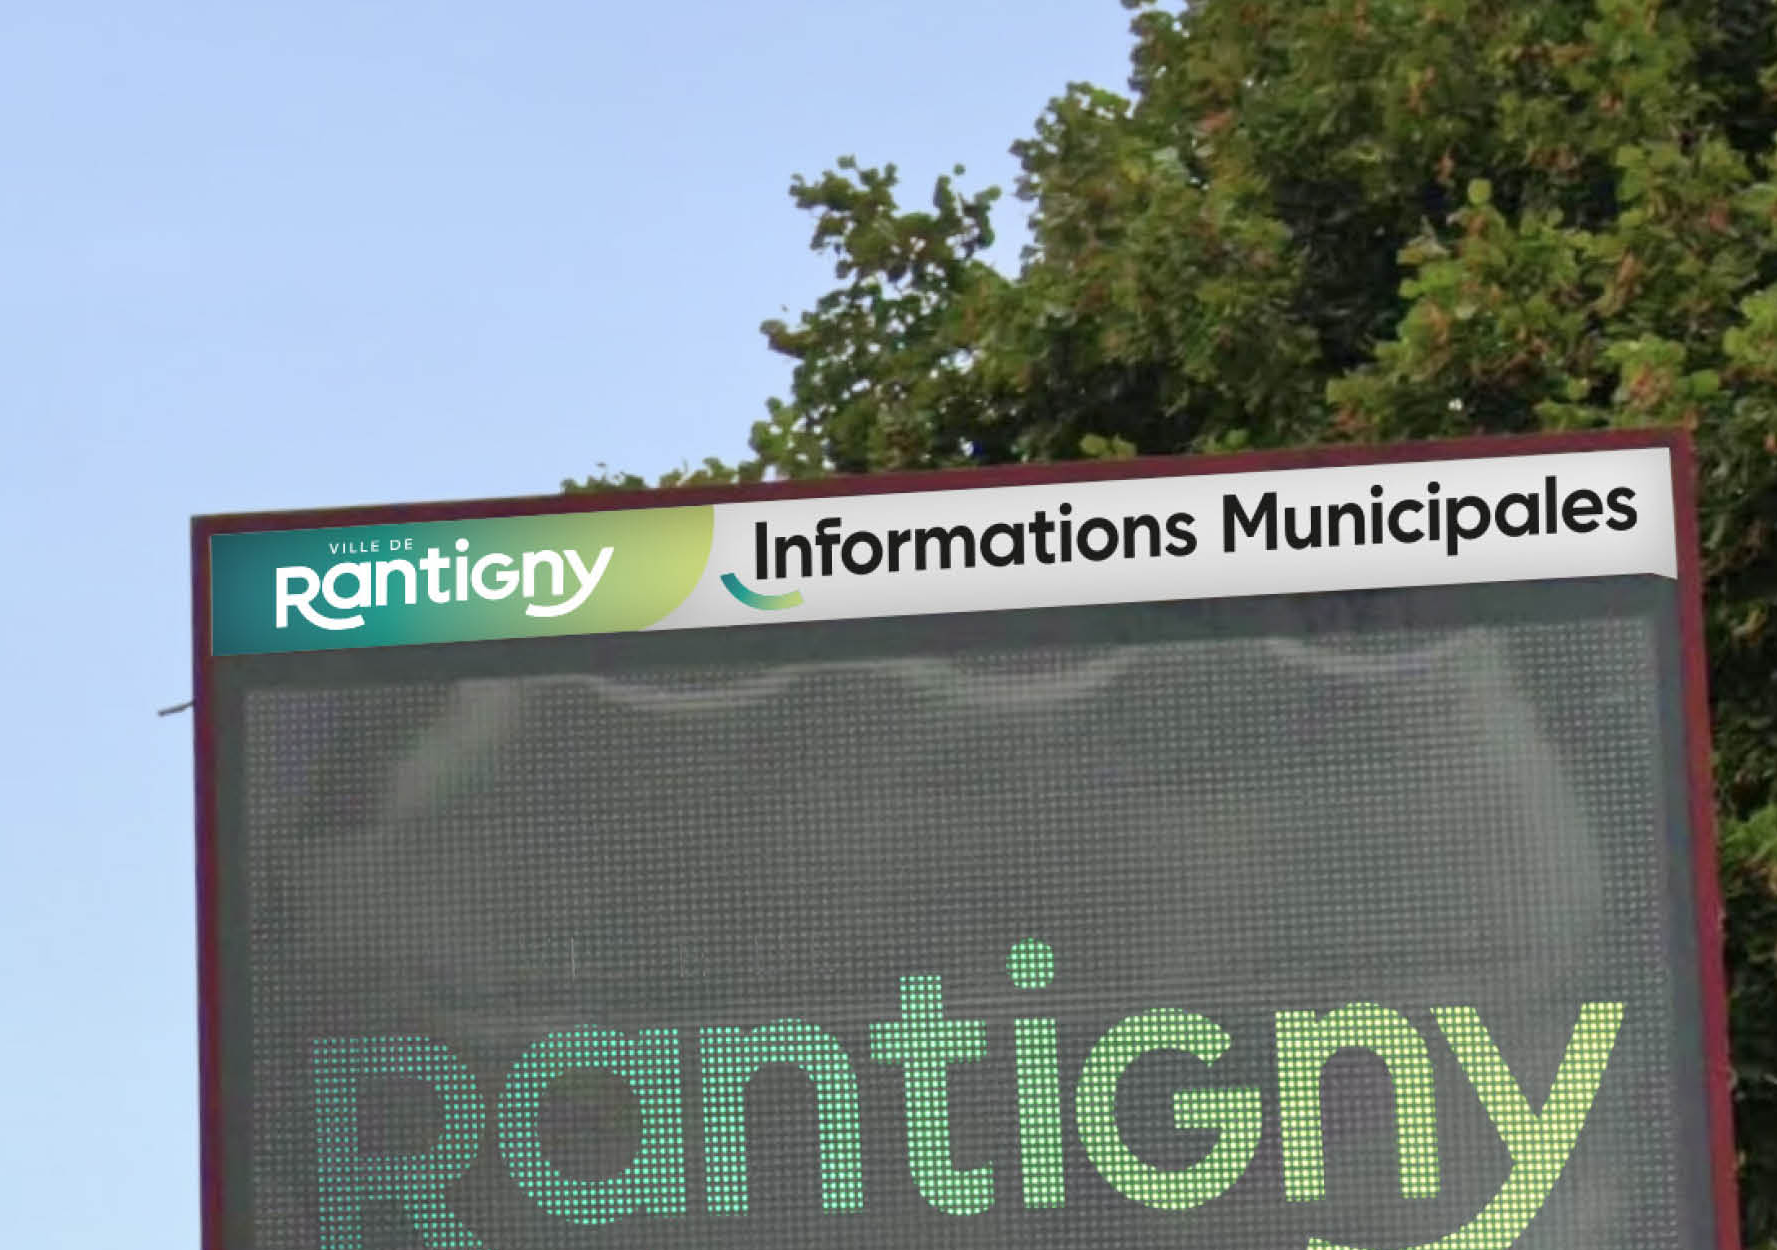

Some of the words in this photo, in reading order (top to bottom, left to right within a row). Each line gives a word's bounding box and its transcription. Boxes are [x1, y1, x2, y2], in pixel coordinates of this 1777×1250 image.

[329, 540, 380, 555] VILLE
[390, 538, 414, 552] DE
[755, 502, 1198, 579] Informations
[1222, 475, 1638, 556] Municipales
